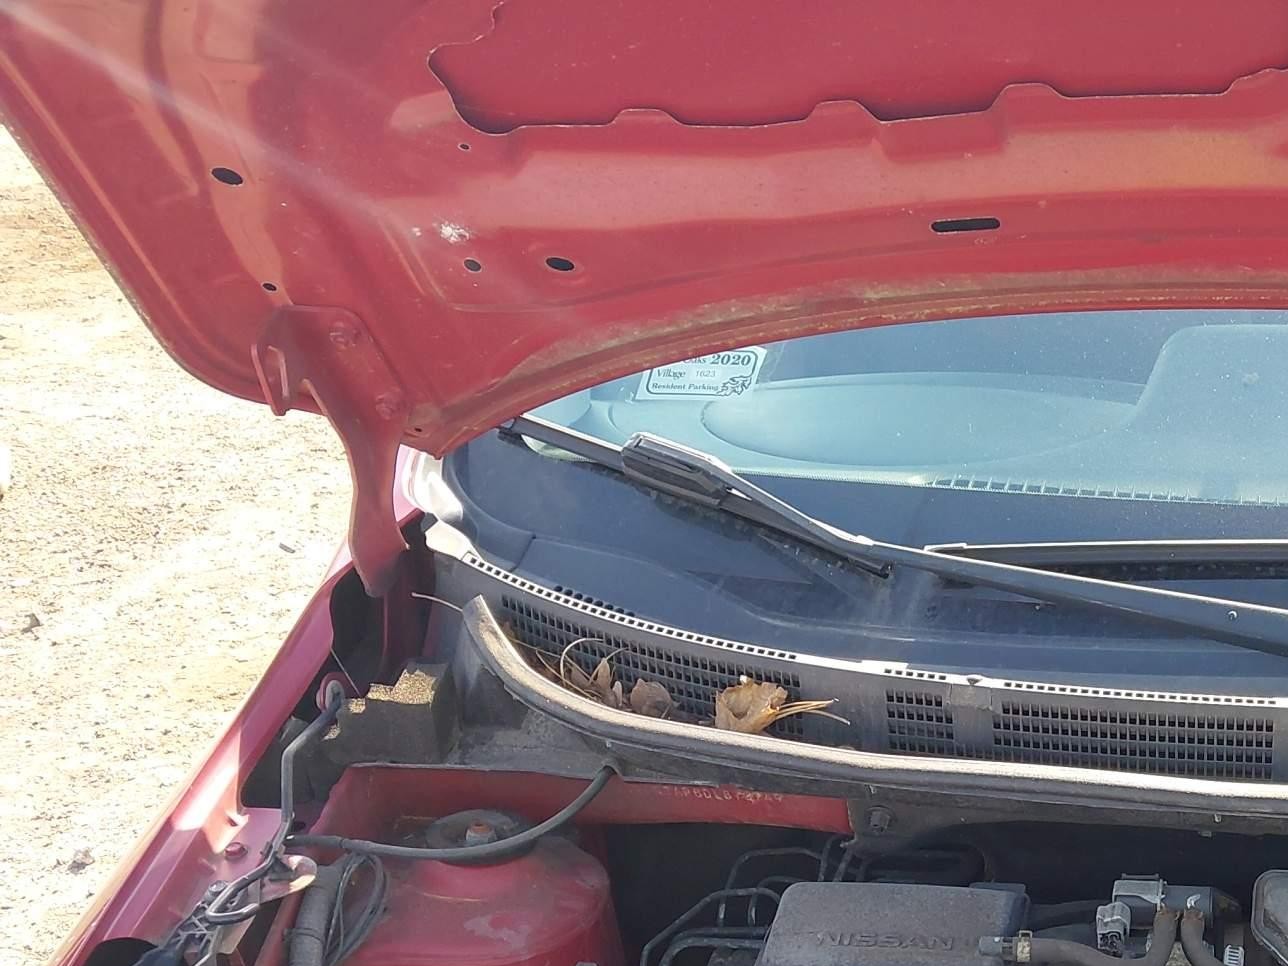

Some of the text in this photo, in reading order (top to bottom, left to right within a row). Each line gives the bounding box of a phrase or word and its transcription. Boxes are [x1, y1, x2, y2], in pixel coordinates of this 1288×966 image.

[710, 354, 751, 366] 2020
[656, 369, 686, 380] Village
[652, 382, 719, 392] Resident Parking
[814, 931, 953, 951] NISSAN
